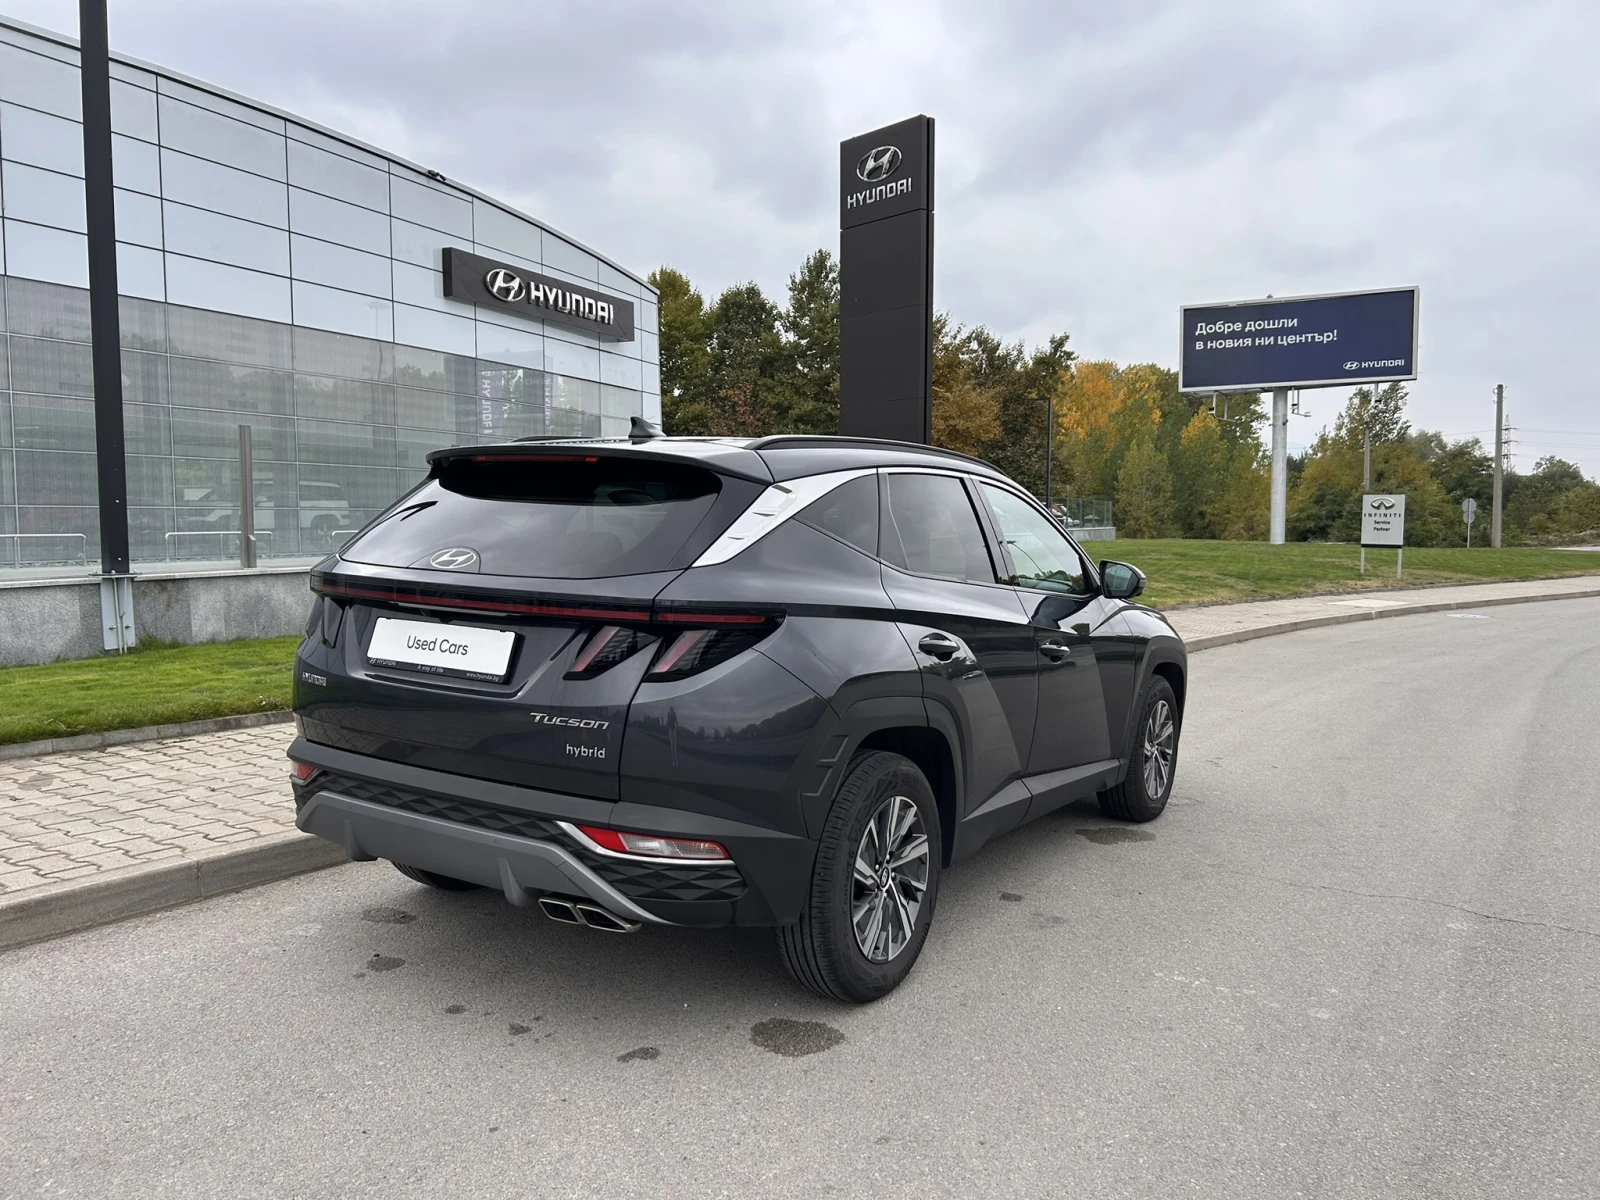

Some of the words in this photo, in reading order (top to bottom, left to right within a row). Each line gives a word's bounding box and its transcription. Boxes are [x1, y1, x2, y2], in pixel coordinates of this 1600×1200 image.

[847, 177, 912, 209] HYUNDAI
[528, 281, 614, 325] HYUNDAI
[1195, 322, 1242, 336] Добре
[1245, 317, 1298, 332] дошли
[1195, 341, 1204, 350] в
[1207, 336, 1252, 349] новия
[1255, 335, 1274, 346] ни
[1277, 329, 1338, 345] център!
[1361, 359, 1405, 369] HYUNDAI
[406, 634, 438, 652] Used
[439, 638, 469, 656] Cars
[466, 671, 500, 682] www.hyundai.bg
[566, 743, 606, 759] hybrid
